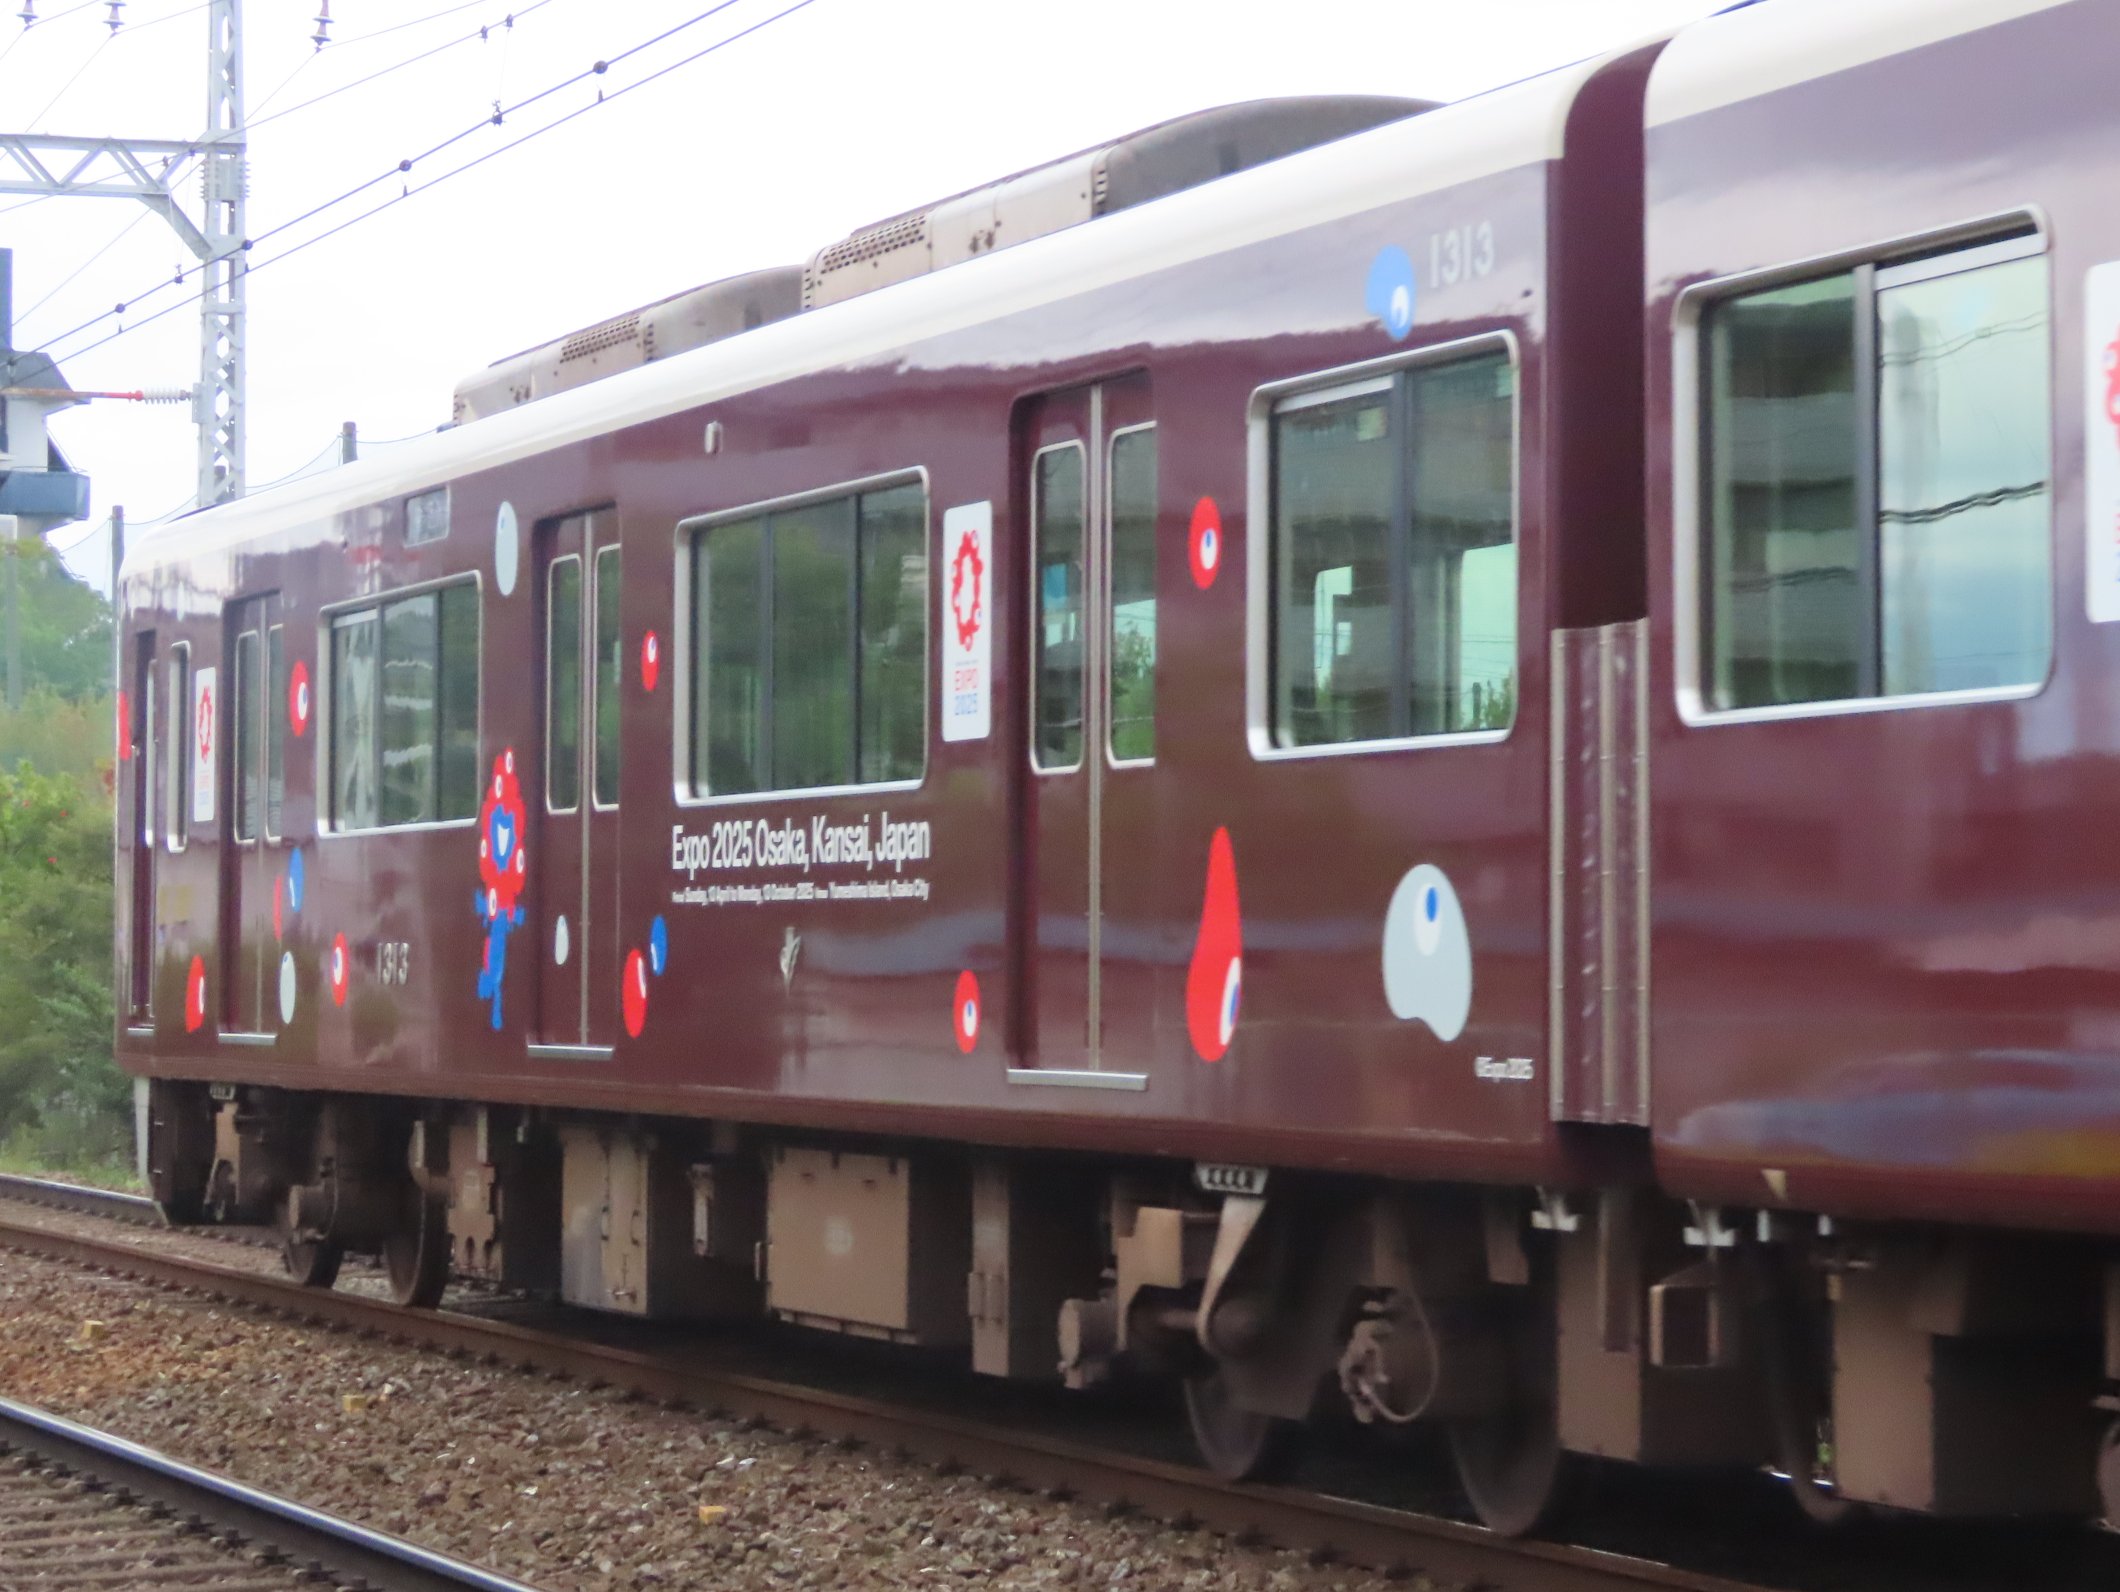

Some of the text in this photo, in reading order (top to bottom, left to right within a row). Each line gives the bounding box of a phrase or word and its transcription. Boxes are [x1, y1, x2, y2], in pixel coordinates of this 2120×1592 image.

[1429, 219, 1495, 289] 1313
[672, 811, 930, 880] Expo 2025 Osaka, Kansai, Japan
[377, 942, 409, 985] 1313
